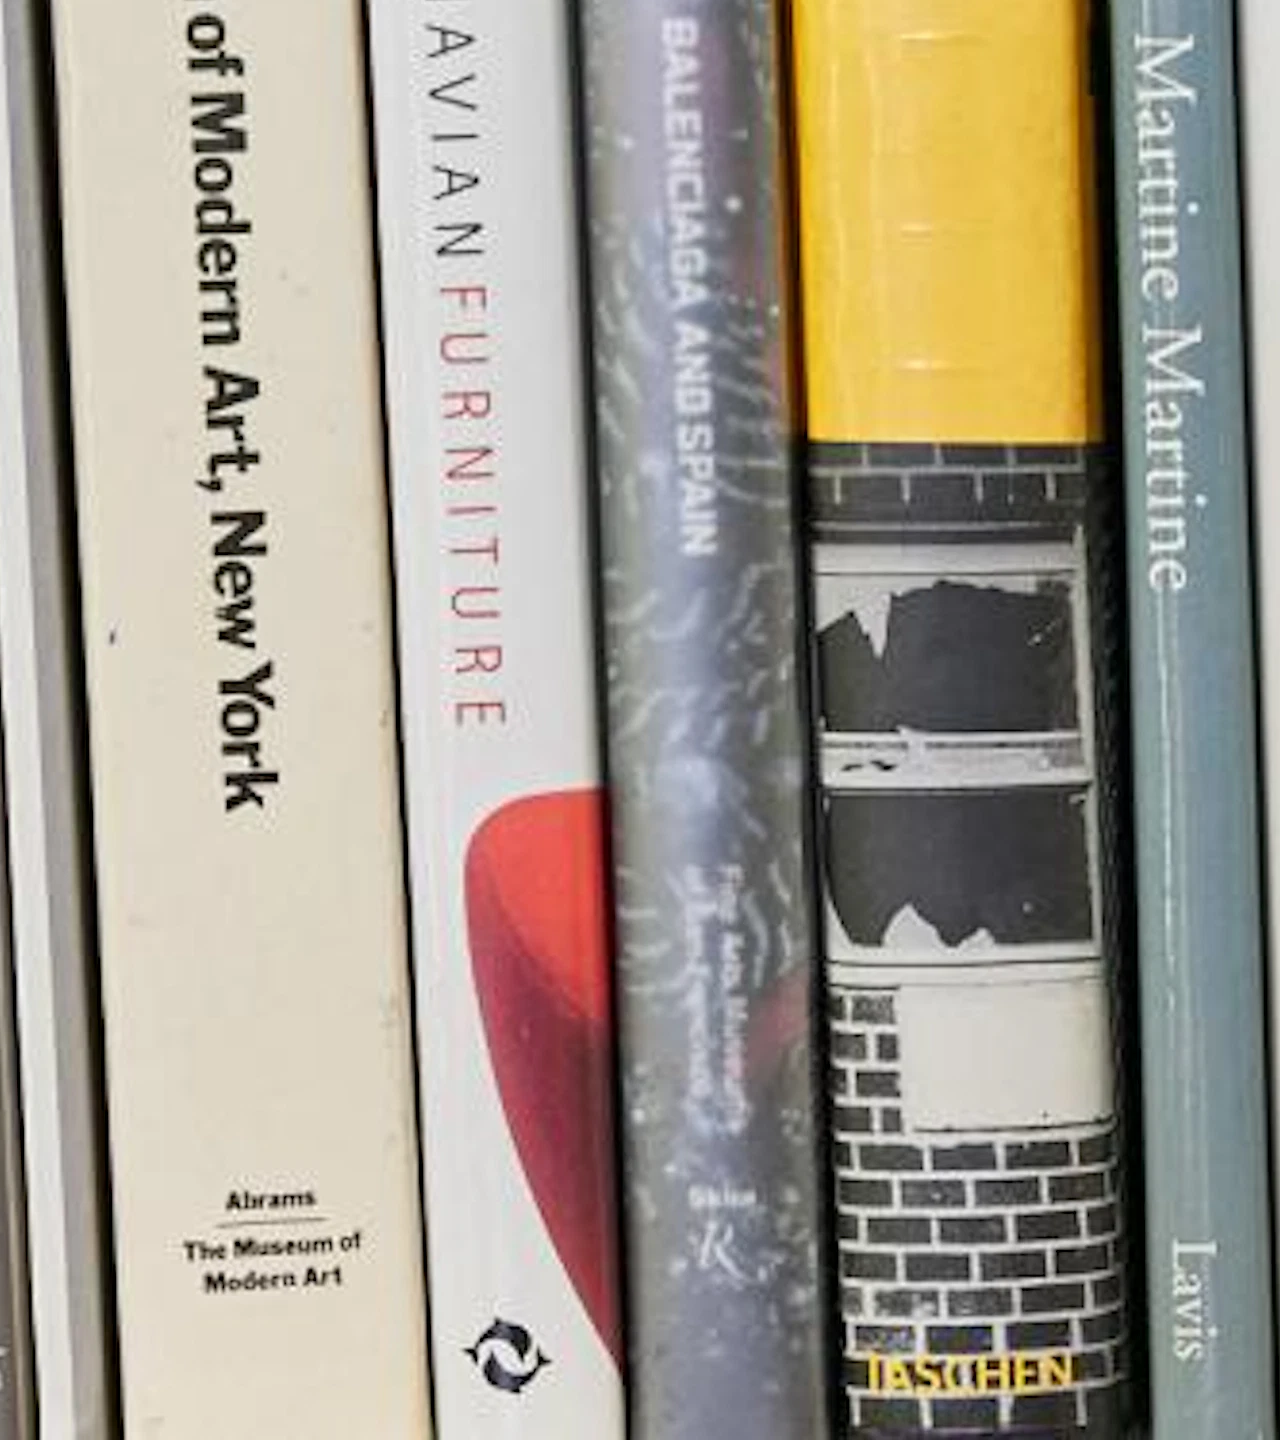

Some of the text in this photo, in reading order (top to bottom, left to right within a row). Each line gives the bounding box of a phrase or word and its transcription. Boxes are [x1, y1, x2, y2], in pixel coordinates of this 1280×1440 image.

[184, 10, 244, 77] of
[189, 93, 253, 347] Modern
[661, 17, 719, 553] BALENCIAGA AND SPAIN
[1135, 33, 1207, 594] Martine Martine
[196, 366, 260, 491] Art,
[438, 286, 507, 727] FURNITURE
[209, 511, 267, 652] New
[220, 660, 278, 815] York
[184, 1230, 362, 1261] The Museum of
[226, 1188, 316, 1210] Abrams
[203, 1266, 342, 1294] Modern Art
[1172, 1238, 1218, 1362] Lavis
[867, 1353, 1073, 1394] TASCHEN
